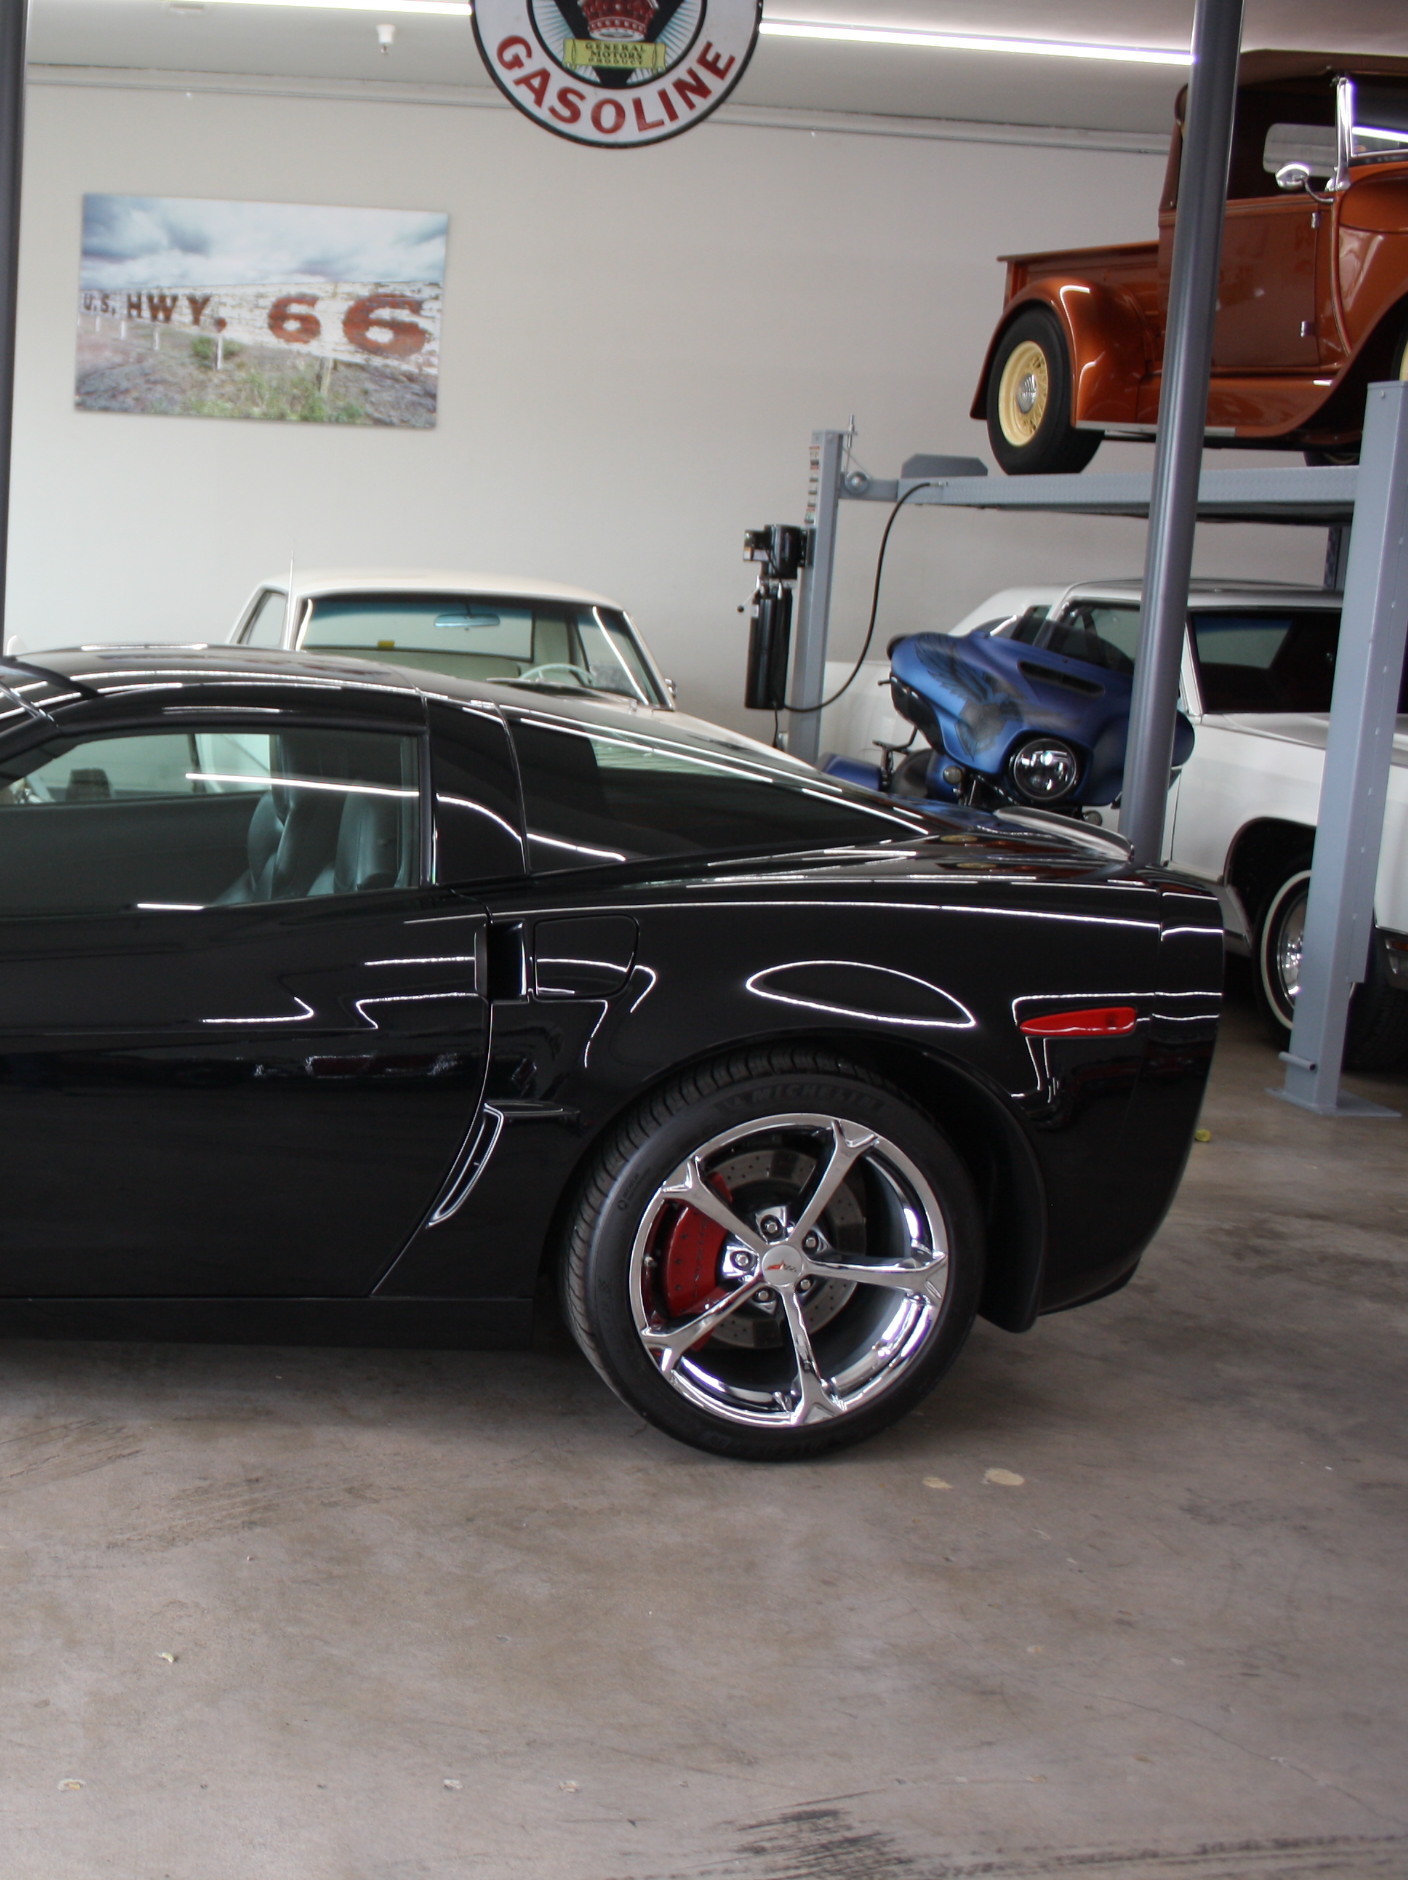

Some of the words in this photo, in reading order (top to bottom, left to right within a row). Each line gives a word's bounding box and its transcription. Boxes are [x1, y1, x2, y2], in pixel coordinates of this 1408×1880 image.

[585, 42, 645, 52] GENERAL
[591, 50, 642, 59] MOTORS
[496, 35, 736, 134] GASOLINE
[127, 292, 227, 333] HWY.
[267, 293, 431, 359] 66
